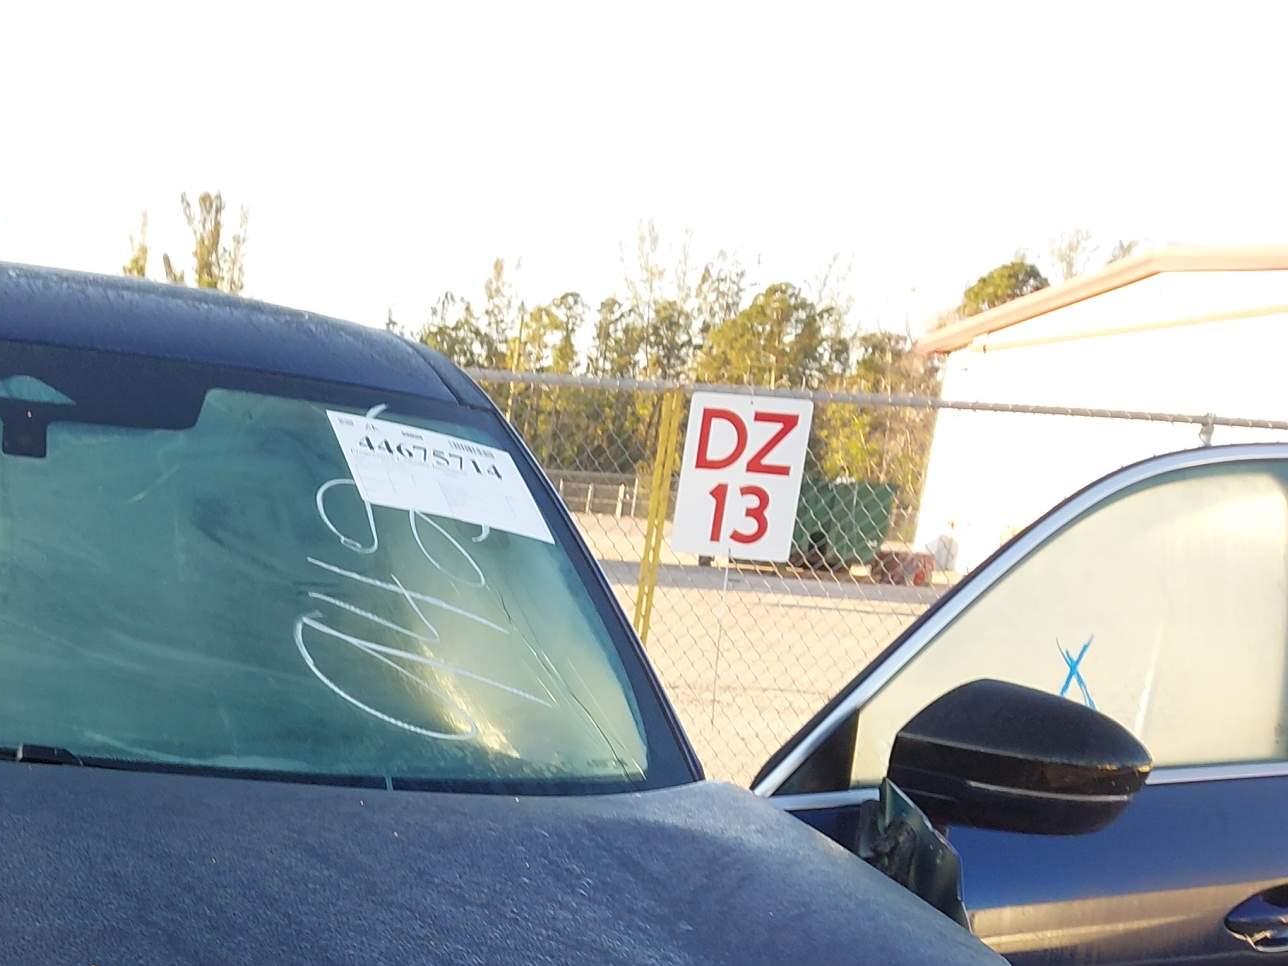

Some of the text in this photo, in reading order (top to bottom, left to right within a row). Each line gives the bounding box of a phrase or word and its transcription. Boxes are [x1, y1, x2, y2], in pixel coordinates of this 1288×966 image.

[359, 435, 503, 480] 44675714
[695, 407, 800, 476] DZ
[709, 482, 770, 544] 13
